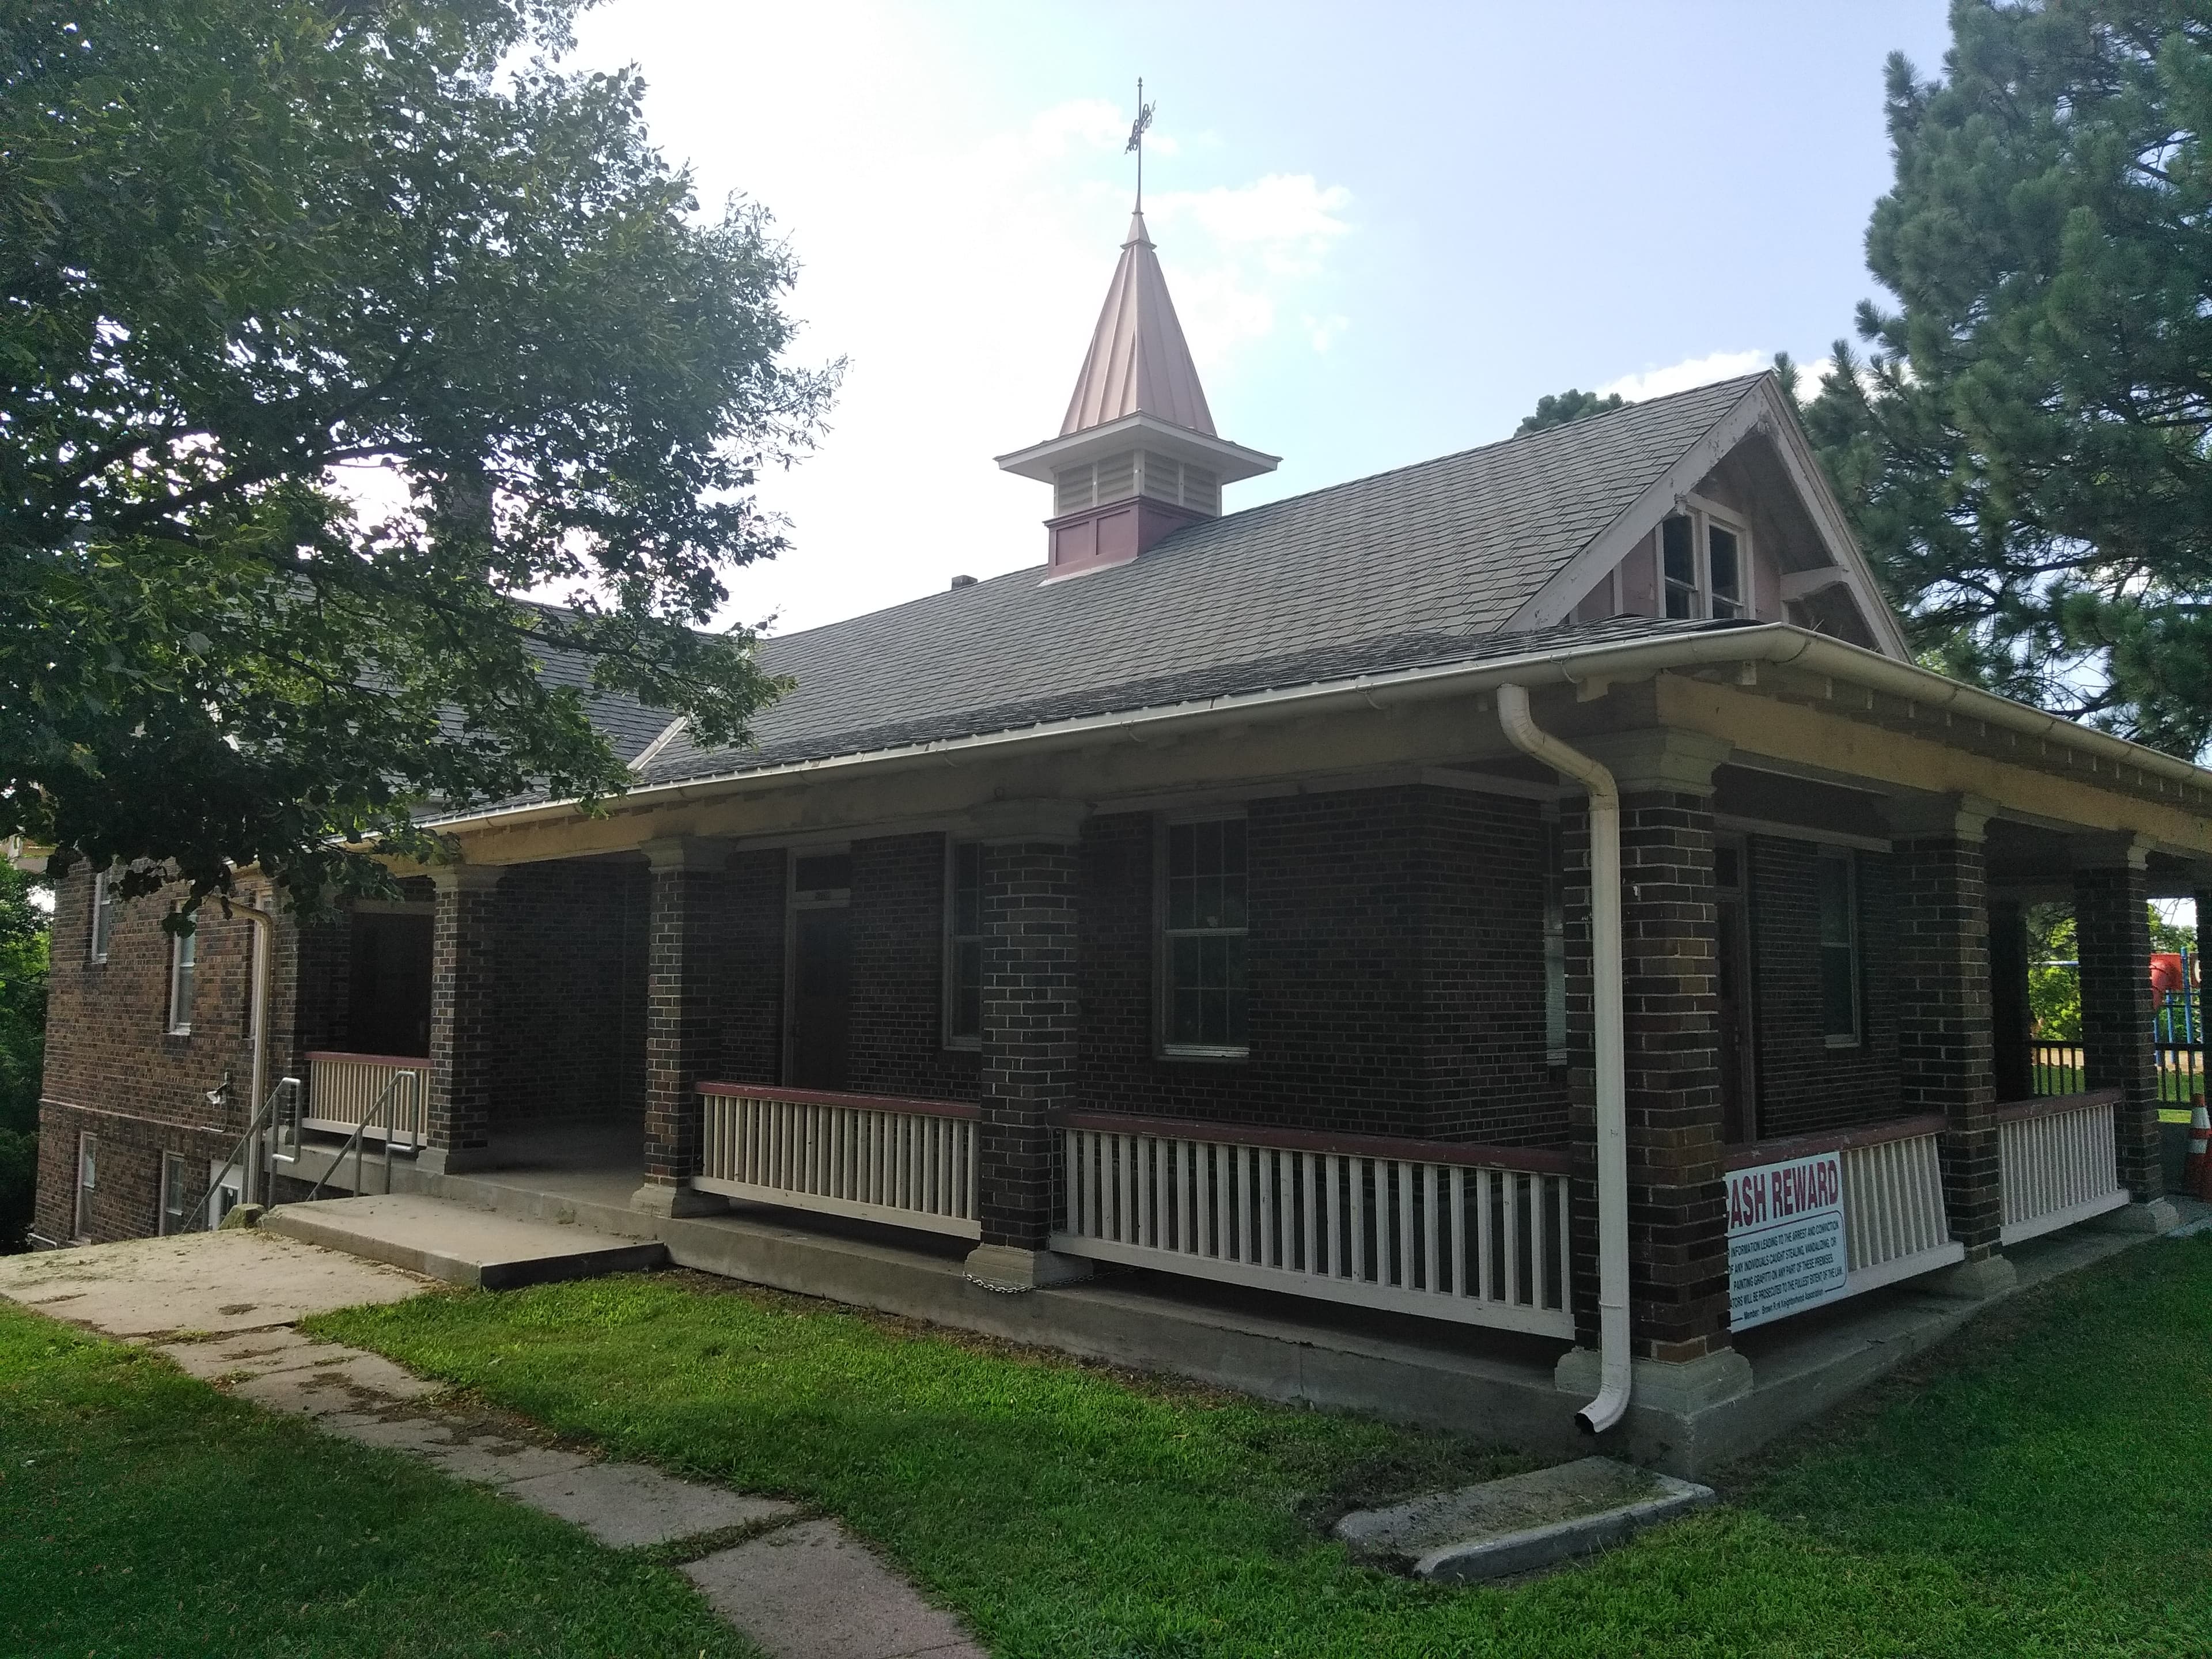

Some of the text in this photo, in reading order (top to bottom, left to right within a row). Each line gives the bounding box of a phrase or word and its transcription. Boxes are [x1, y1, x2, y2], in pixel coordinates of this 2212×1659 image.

[1772, 1160, 1838, 1218] REWARD
[1761, 1236, 1777, 1249] LEADING
[1778, 1234, 1783, 1244] TO
[1783, 1232, 1791, 1243] THE
[1792, 1228, 1806, 1240] ARREST
[1816, 1220, 1839, 1234] CONVICTION
[1733, 1276, 1753, 1290] PAINTING
[1771, 1269, 1777, 1279] ON
[1778, 1267, 1786, 1277] ANY
[1786, 1264, 1796, 1275] PART
[1796, 1262, 1801, 1272] OF
[1802, 1259, 1814, 1271] THESE
[1815, 1253, 1834, 1267] PREMISES
[1734, 1262, 1743, 1273] ANY
[1831, 1237, 1836, 1246] OR
[1743, 1293, 1752, 1304] WILL
[1753, 1291, 1758, 1301] BE
[1759, 1284, 1782, 1300] PROSECUTED
[1782, 1283, 1787, 1293] TO
[1795, 1276, 1809, 1289] FULLEST
[1823, 1271, 1827, 1281] OF
[1827, 1268, 1835, 1279] THE
